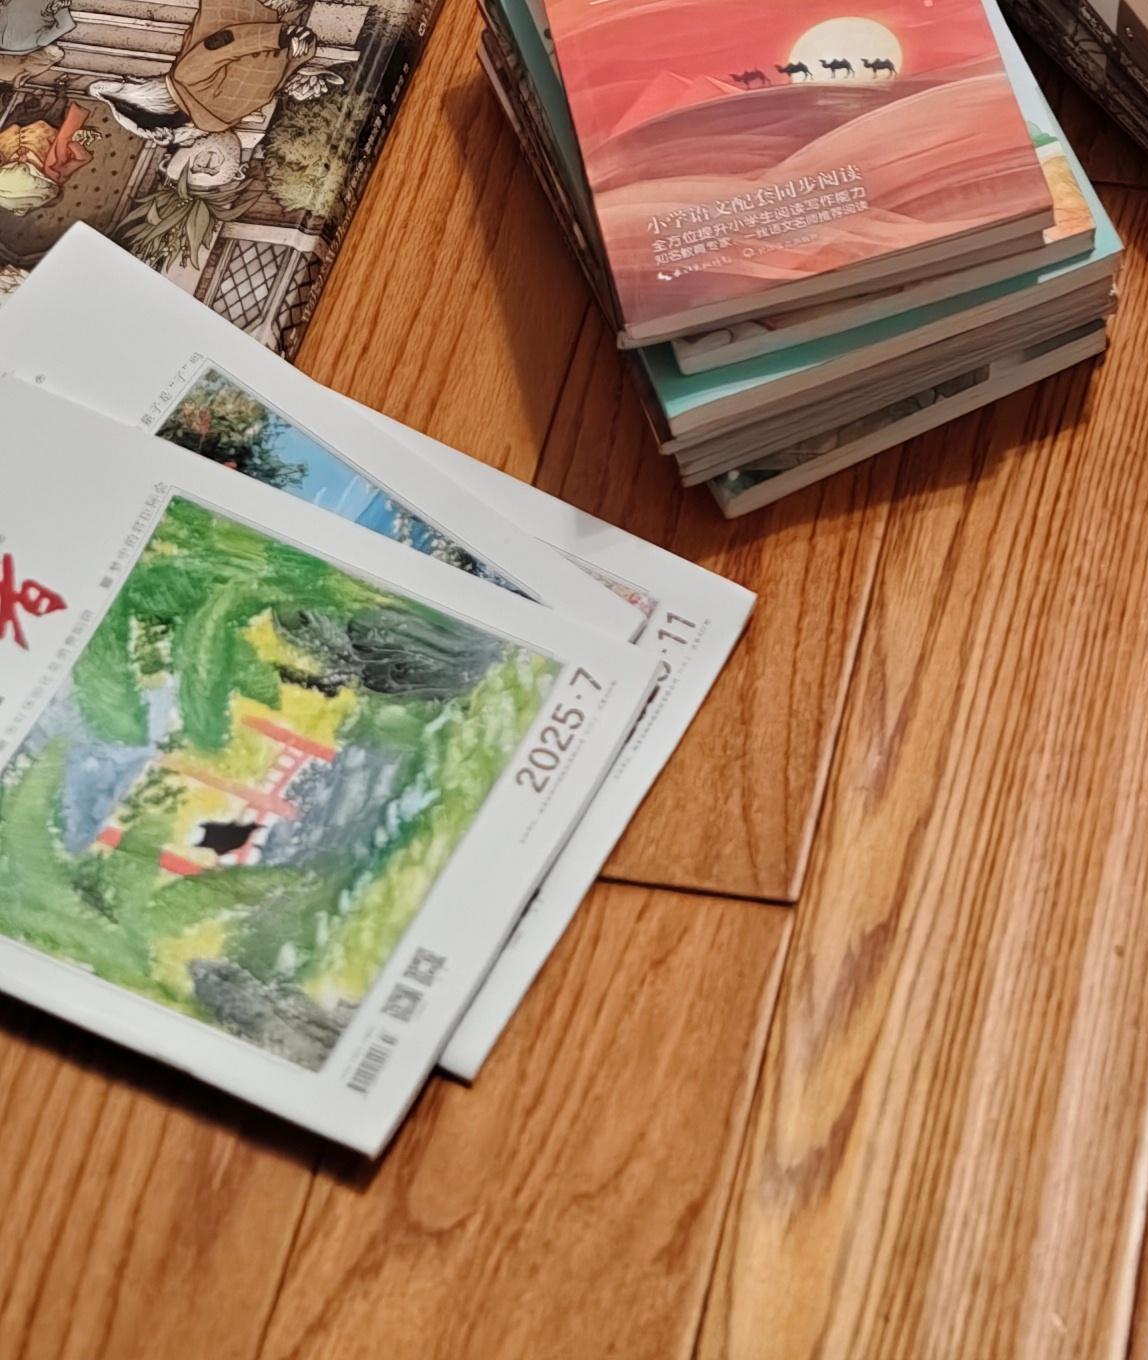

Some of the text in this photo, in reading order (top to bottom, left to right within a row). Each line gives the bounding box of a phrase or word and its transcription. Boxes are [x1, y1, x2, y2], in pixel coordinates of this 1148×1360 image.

[647, 163, 863, 235] 小学语文配套同步阅读
[651, 186, 867, 254] 全方位提升小学生阅读写作能力
[514, 665, 598, 798] 2025·7
